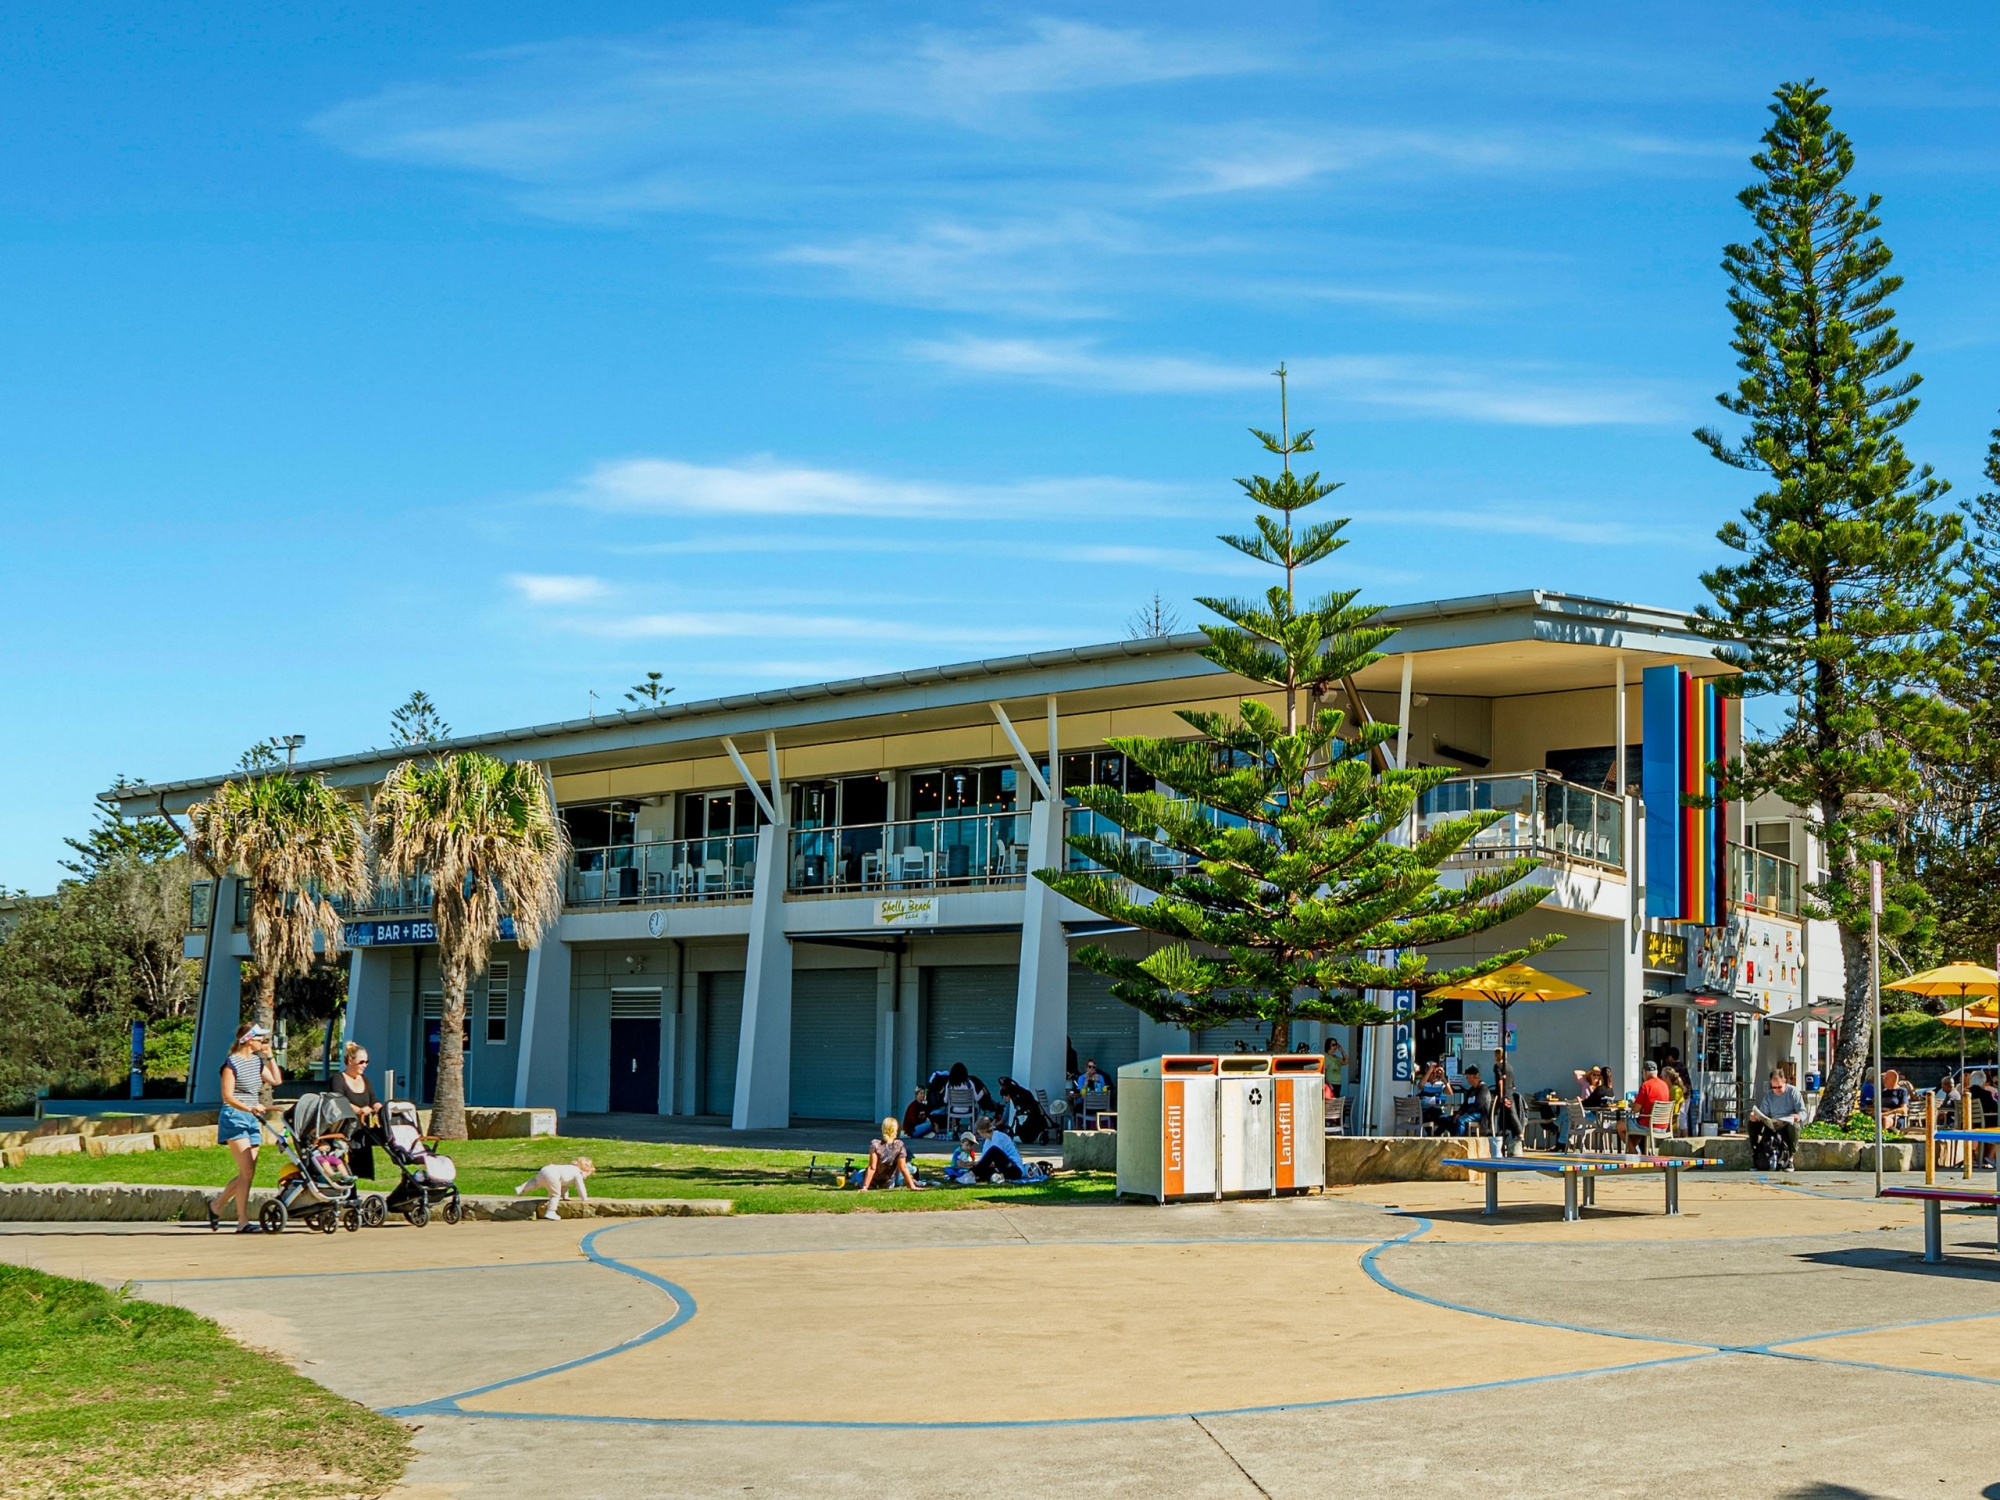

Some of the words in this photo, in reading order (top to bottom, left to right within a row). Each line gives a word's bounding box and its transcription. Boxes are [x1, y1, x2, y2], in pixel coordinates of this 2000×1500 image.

[881, 901, 905, 915] Shelly
[909, 900, 931, 911] Beach
[377, 925, 400, 941] BAR
[1168, 1105, 1181, 1171] Landfill
[1279, 1102, 1291, 1166] Landfill
